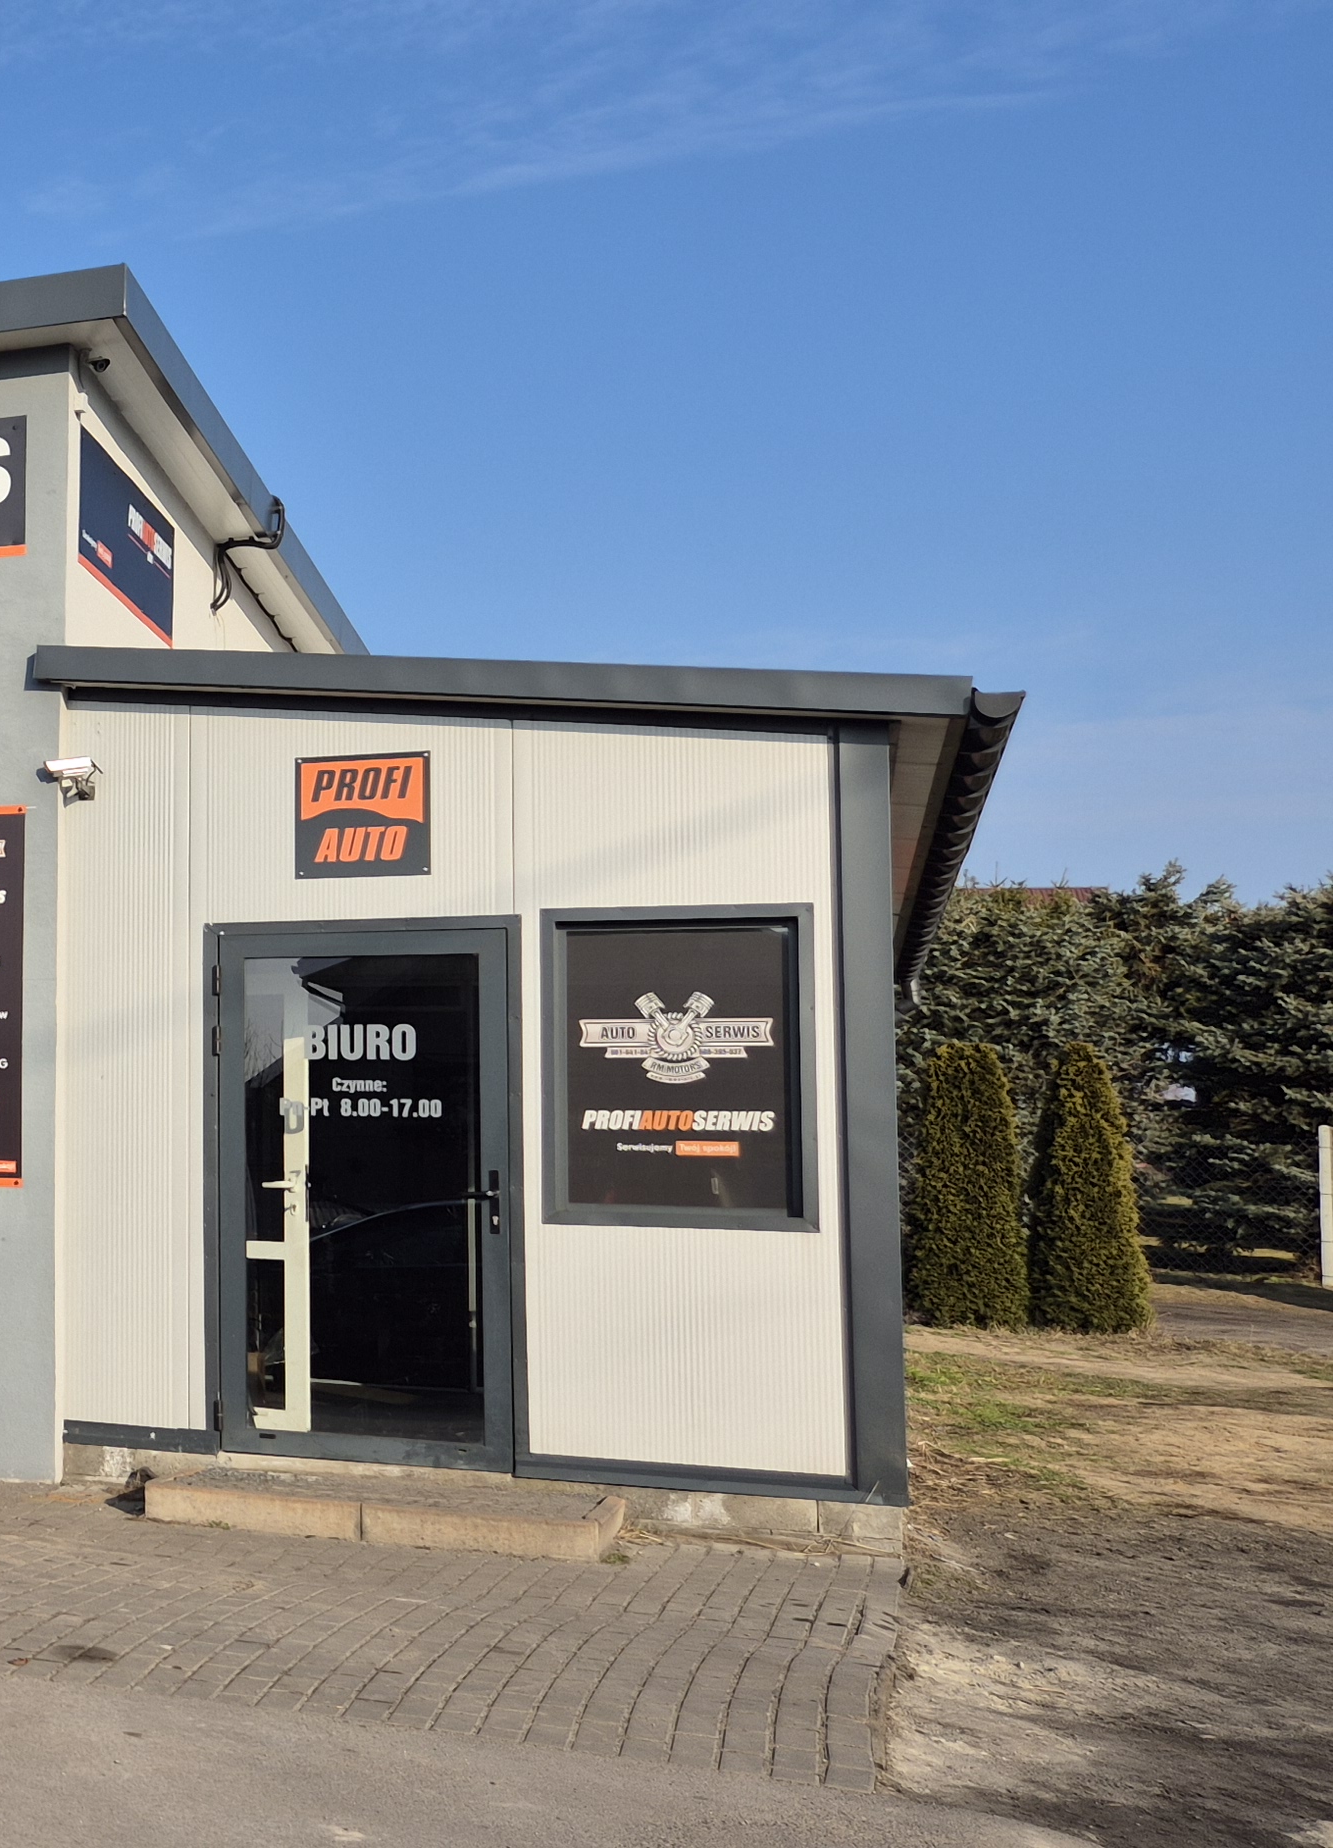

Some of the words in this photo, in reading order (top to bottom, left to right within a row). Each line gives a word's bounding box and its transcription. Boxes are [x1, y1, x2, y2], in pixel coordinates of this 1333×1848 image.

[311, 765, 412, 802] PROFI
[314, 826, 407, 863] AUTO
[304, 1023, 417, 1061] BIURO
[601, 1026, 635, 1040] AUTO
[705, 1025, 760, 1039] SERWIS
[332, 1077, 387, 1094] Czynne:
[340, 1098, 442, 1118] 8.00-17.00
[582, 1109, 776, 1131] PROFIAUTOSERWIS
